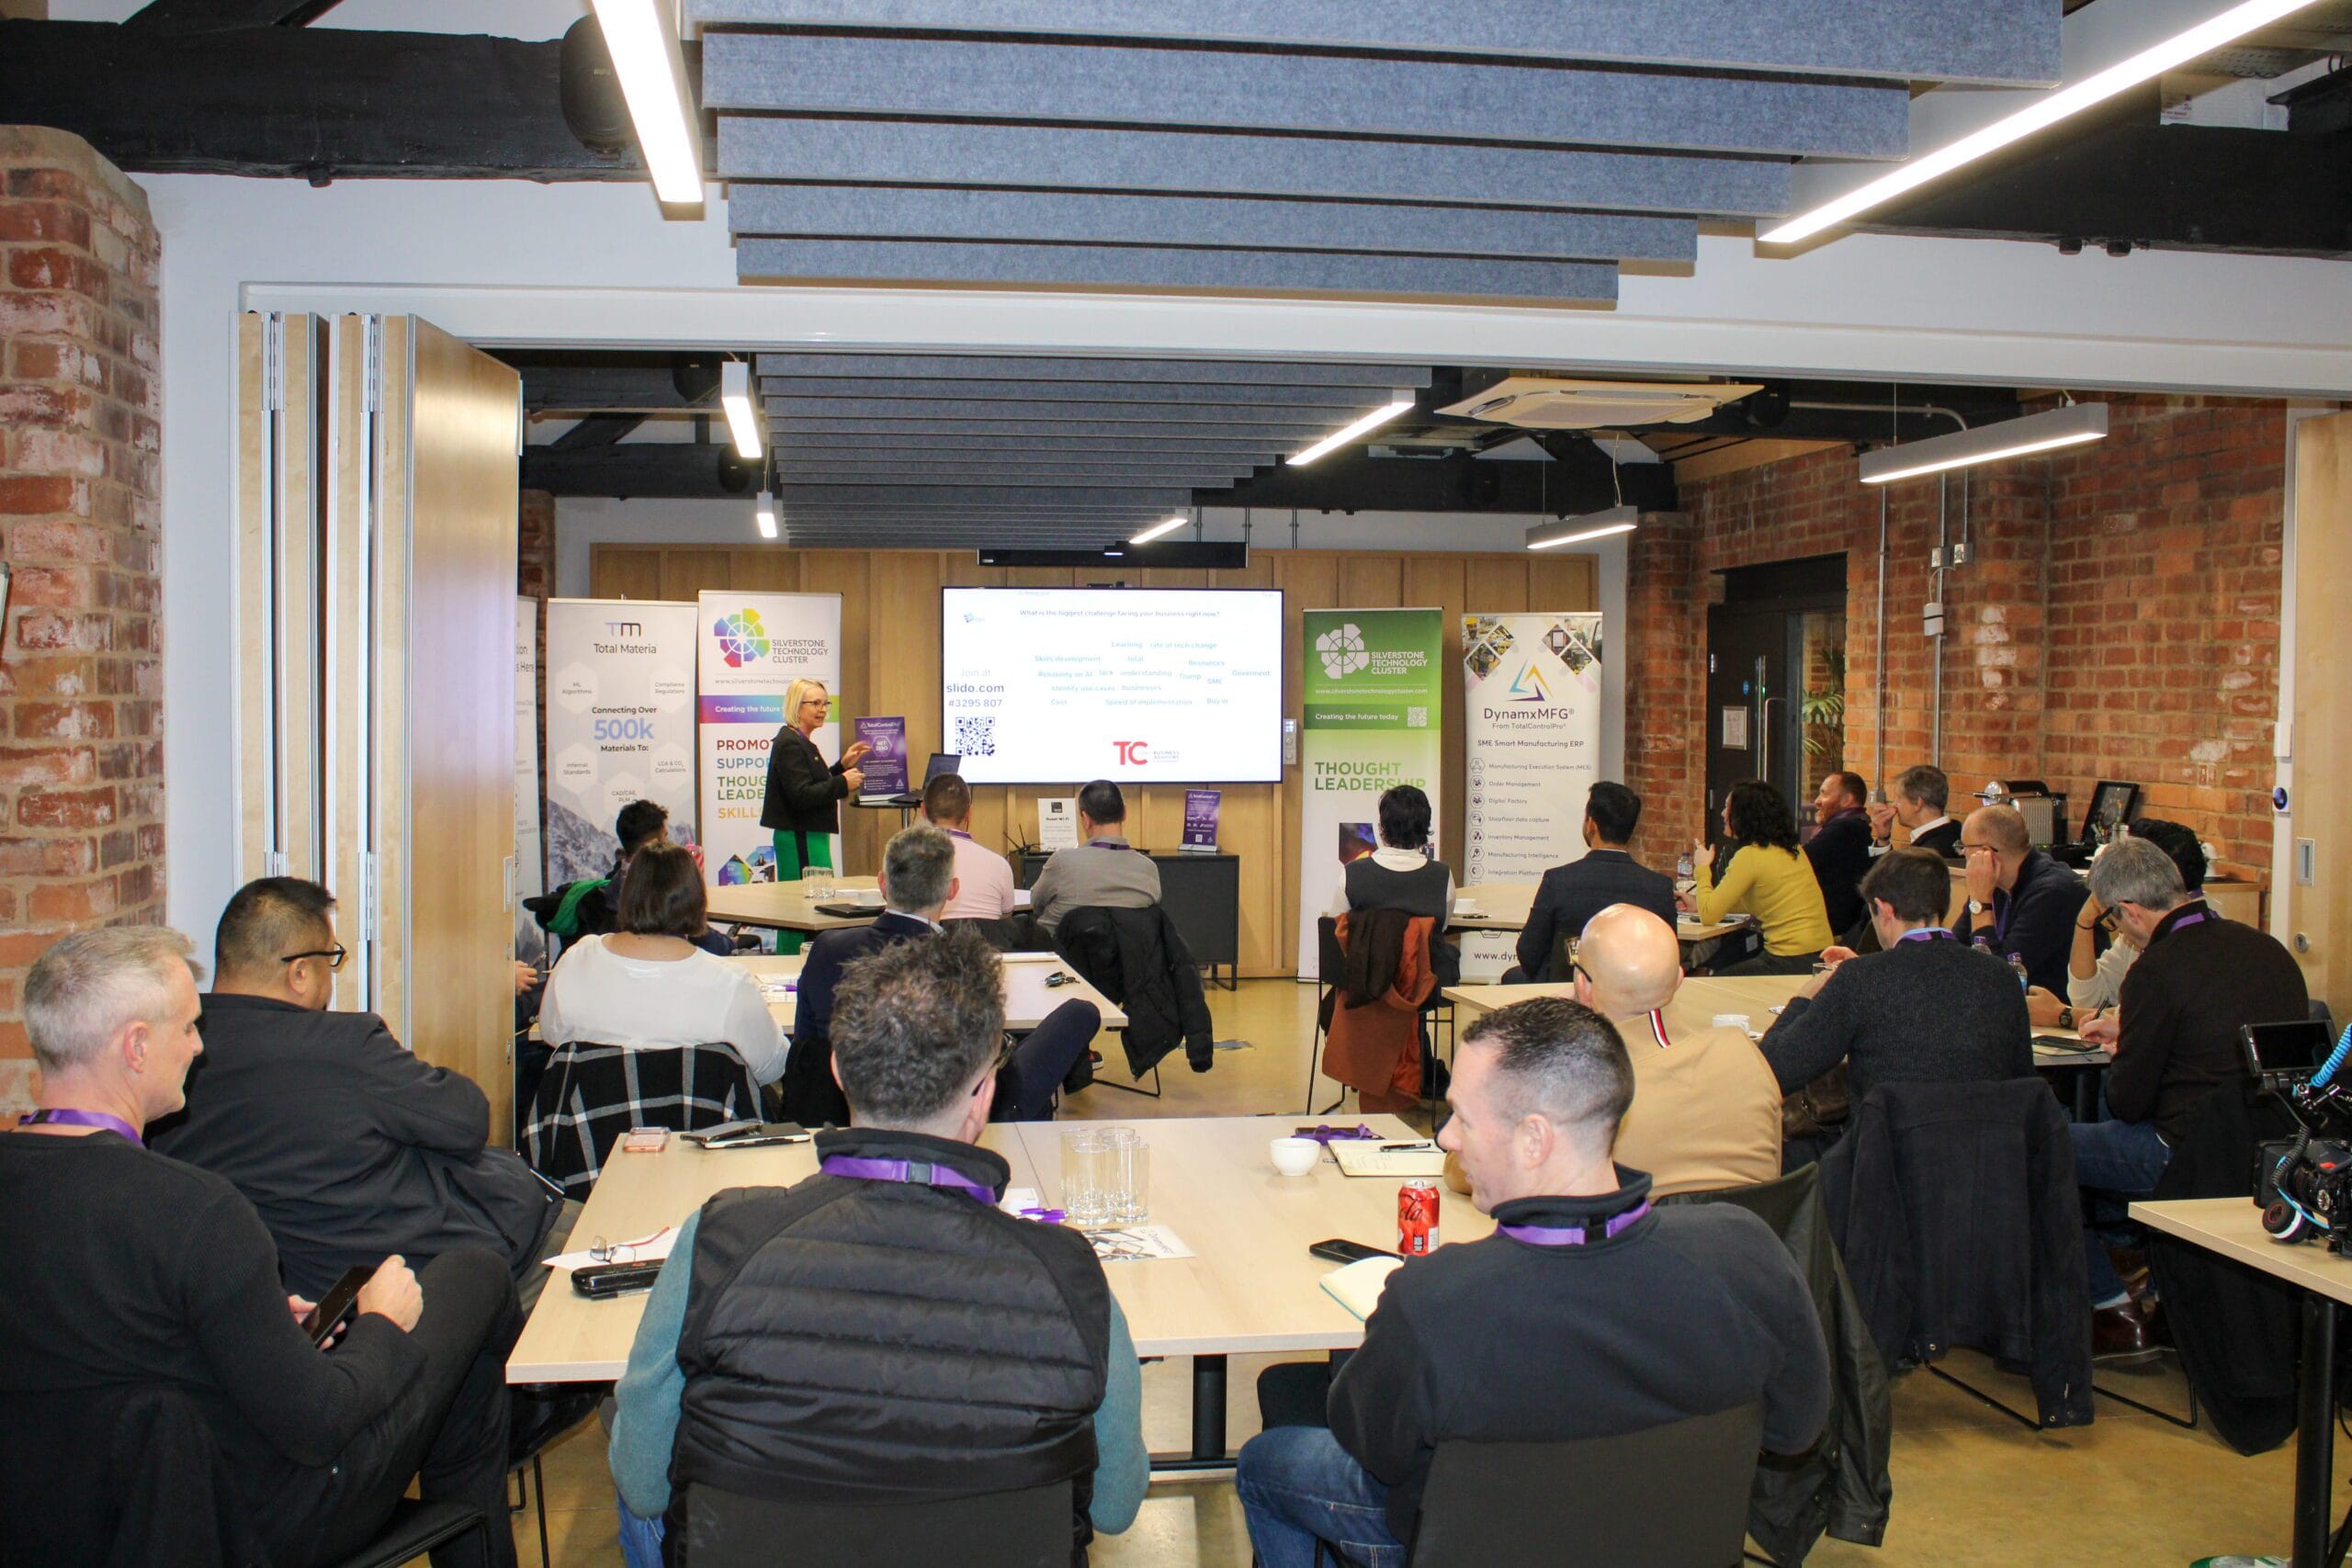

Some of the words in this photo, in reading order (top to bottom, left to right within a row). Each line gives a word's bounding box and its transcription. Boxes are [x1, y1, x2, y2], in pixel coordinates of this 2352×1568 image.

[594, 643, 617, 653] Total
[620, 644, 657, 654] Materia
[1371, 659, 1428, 667] TECHNOLOGY
[961, 669, 979, 677] Join
[982, 669, 991, 677] at
[946, 683, 1004, 694] slido.com
[948, 699, 981, 707] #3295
[983, 699, 1003, 707] 807
[592, 706, 637, 716] Connecting
[715, 705, 745, 714] Creating
[1315, 713, 1344, 721] Creating
[594, 718, 654, 740] 500k
[717, 739, 771, 750] PROMO
[1518, 739, 1568, 749] Manufacturing
[1113, 741, 1148, 765] TC
[1315, 761, 1402, 775] THOUGHT
